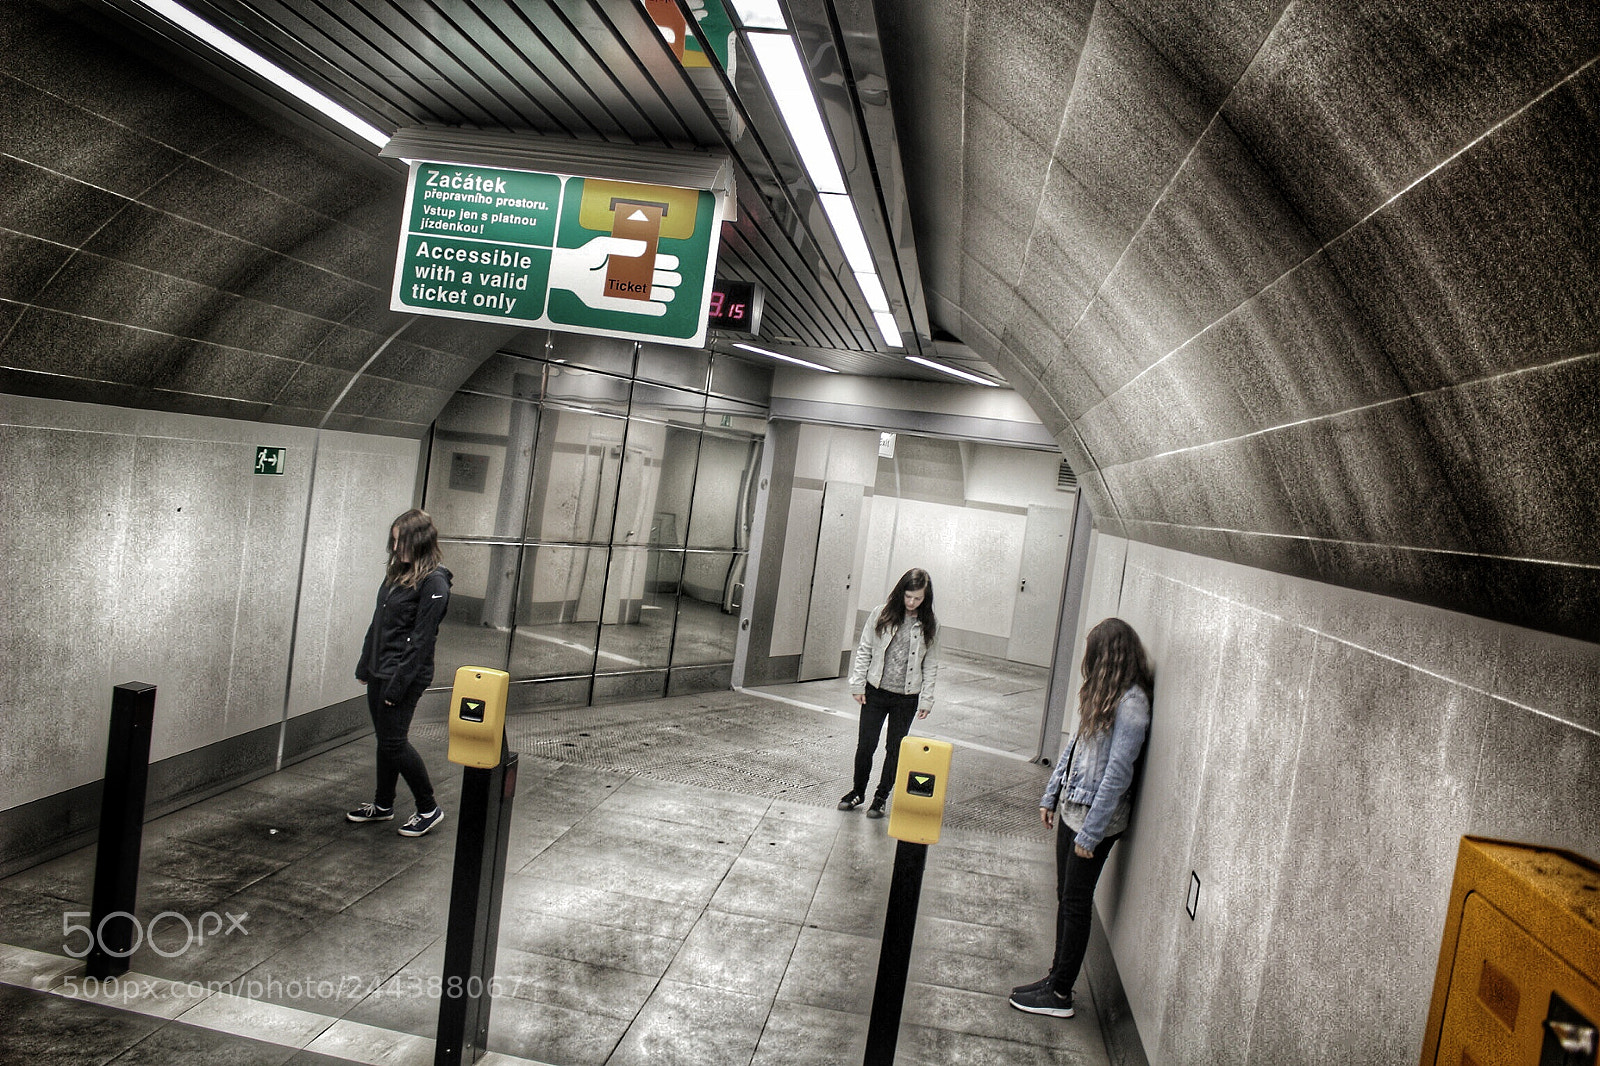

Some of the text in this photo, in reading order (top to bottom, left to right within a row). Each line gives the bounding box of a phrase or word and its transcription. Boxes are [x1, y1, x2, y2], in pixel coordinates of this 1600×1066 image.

[425, 170, 507, 194] Začátek
[423, 188, 549, 211] přepravního prostoru.
[423, 205, 537, 226] Vstup jen s platnou
[415, 241, 532, 269] Accessible
[415, 263, 528, 291] with a valid
[608, 278, 648, 294] Ticket
[412, 283, 517, 315] ticket only
